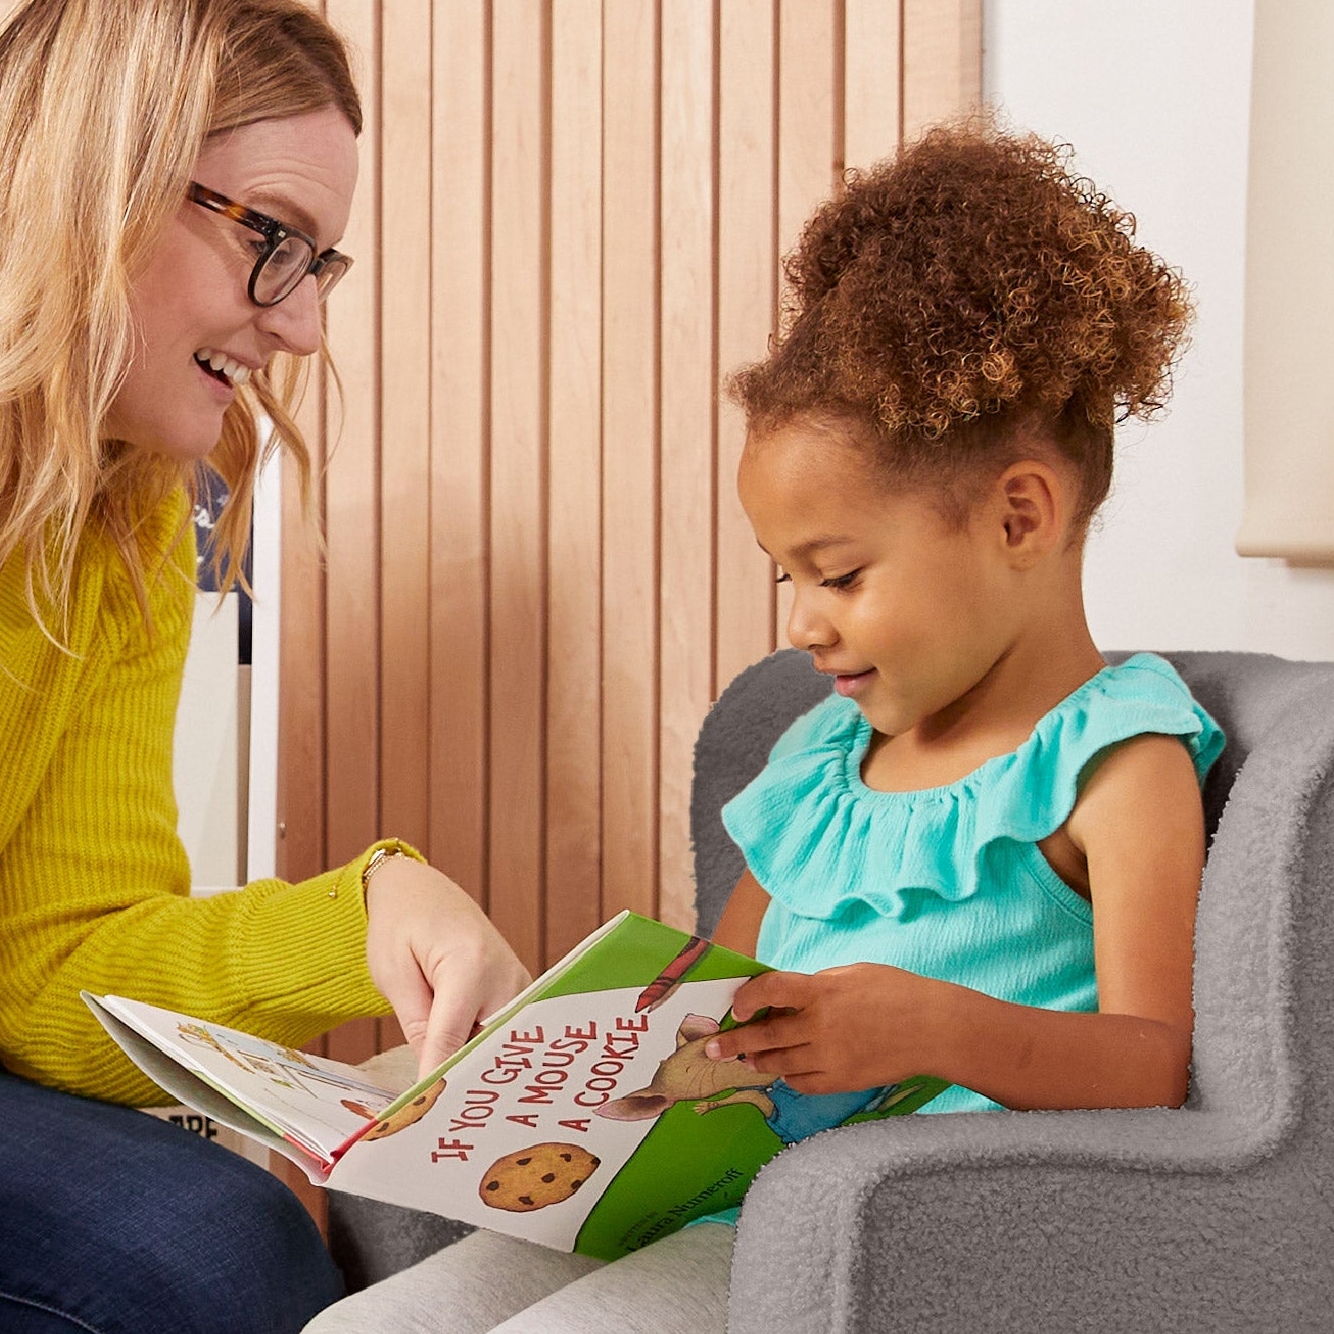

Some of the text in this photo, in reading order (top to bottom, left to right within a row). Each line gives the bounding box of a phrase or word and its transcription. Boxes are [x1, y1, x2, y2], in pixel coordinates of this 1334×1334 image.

[431, 1025, 545, 1163] IF YOU GIVE
[505, 1020, 597, 1128] A MOUSE
[558, 1014, 649, 1132] A COOKIE
[669, 1167, 744, 1218] Numeroff
